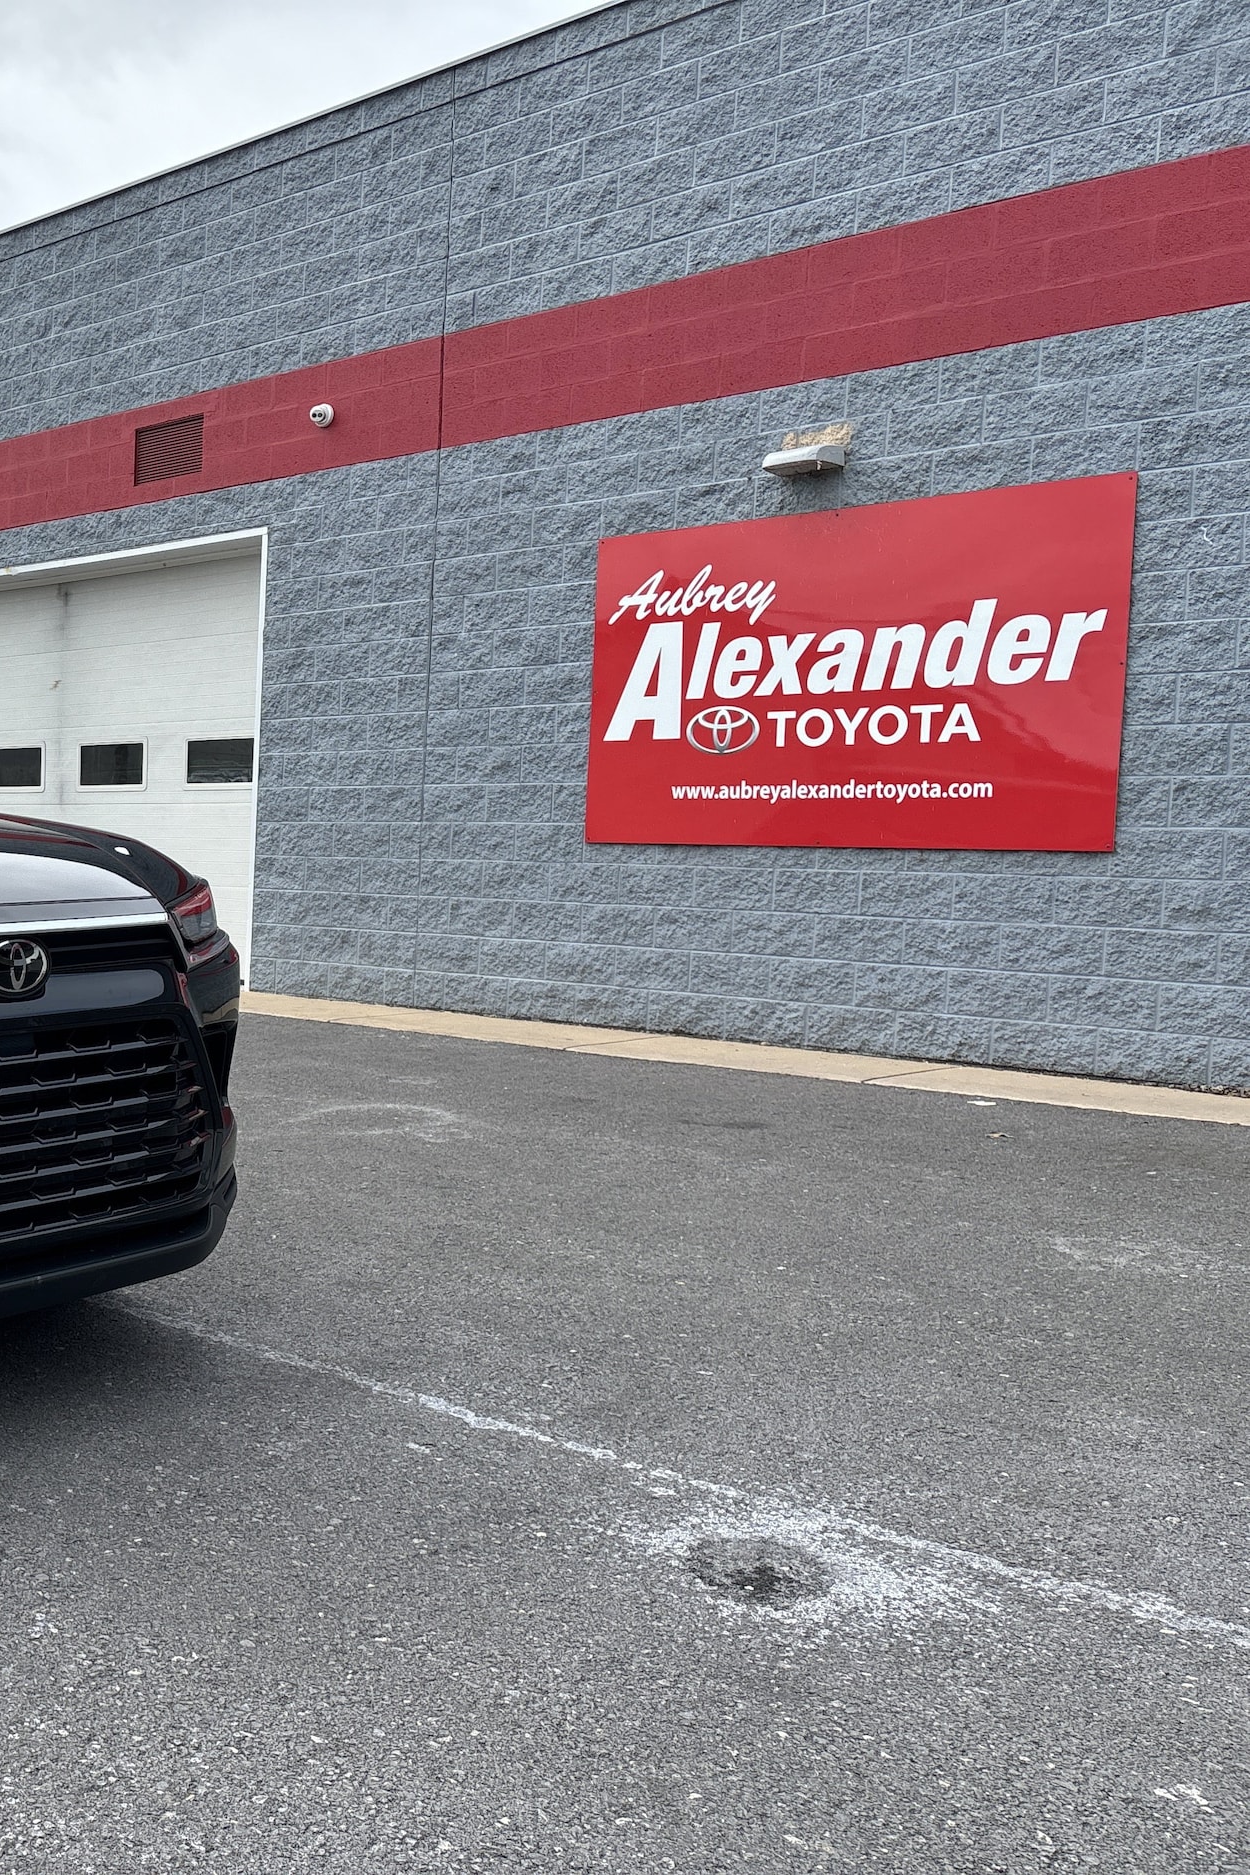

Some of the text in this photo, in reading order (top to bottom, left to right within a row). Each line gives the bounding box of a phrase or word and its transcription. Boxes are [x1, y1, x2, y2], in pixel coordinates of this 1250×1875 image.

[608, 564, 777, 626] Aubrey
[602, 598, 1108, 742] Alexander
[766, 702, 981, 748] TOYOTA
[671, 778, 993, 804] www.aubreyalexandertoyota.com
